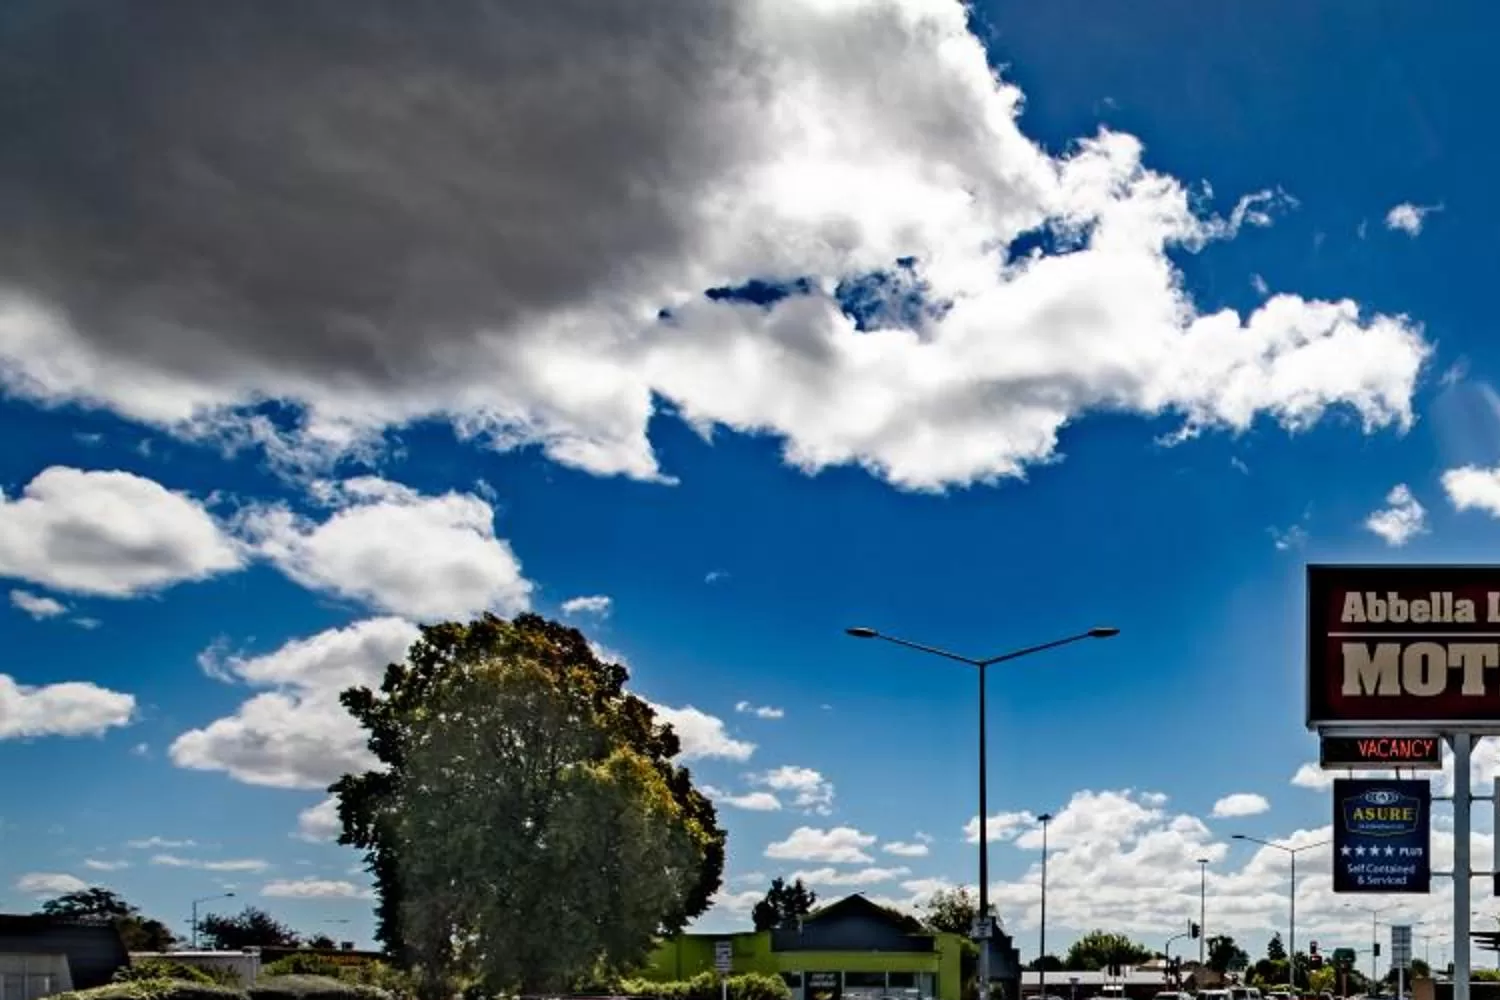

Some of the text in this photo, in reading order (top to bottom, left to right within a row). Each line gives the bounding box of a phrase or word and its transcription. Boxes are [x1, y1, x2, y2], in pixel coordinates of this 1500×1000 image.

[1341, 591, 1476, 624] Abbella
[1357, 738, 1433, 758] VACANCY
[1352, 807, 1414, 821] ASURE
[1347, 863, 1416, 875] Self Contained
